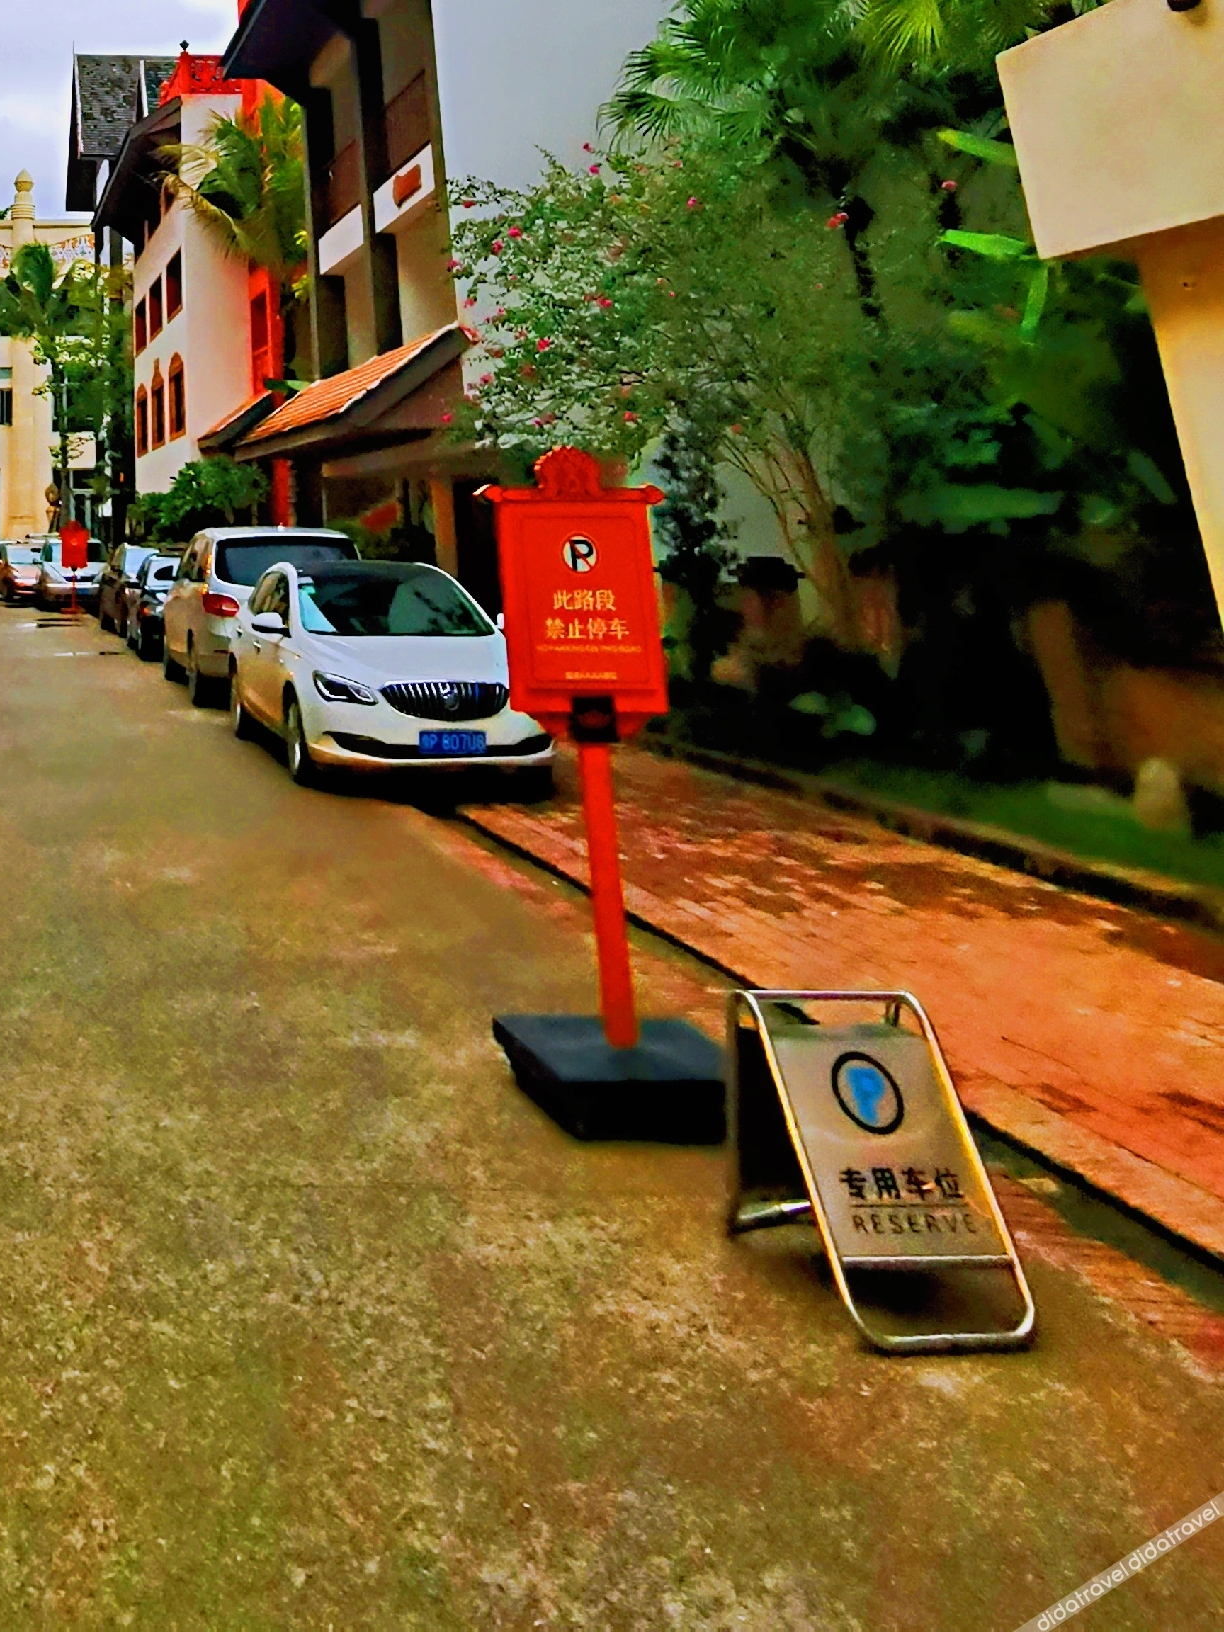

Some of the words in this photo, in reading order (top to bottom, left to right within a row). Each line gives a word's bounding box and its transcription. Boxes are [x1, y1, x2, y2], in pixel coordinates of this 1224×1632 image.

[553, 589, 616, 611] 此路段
[545, 618, 629, 640] 禁止停车
[839, 1166, 966, 1201] 专用车位
[853, 1213, 978, 1235] RESERVE
